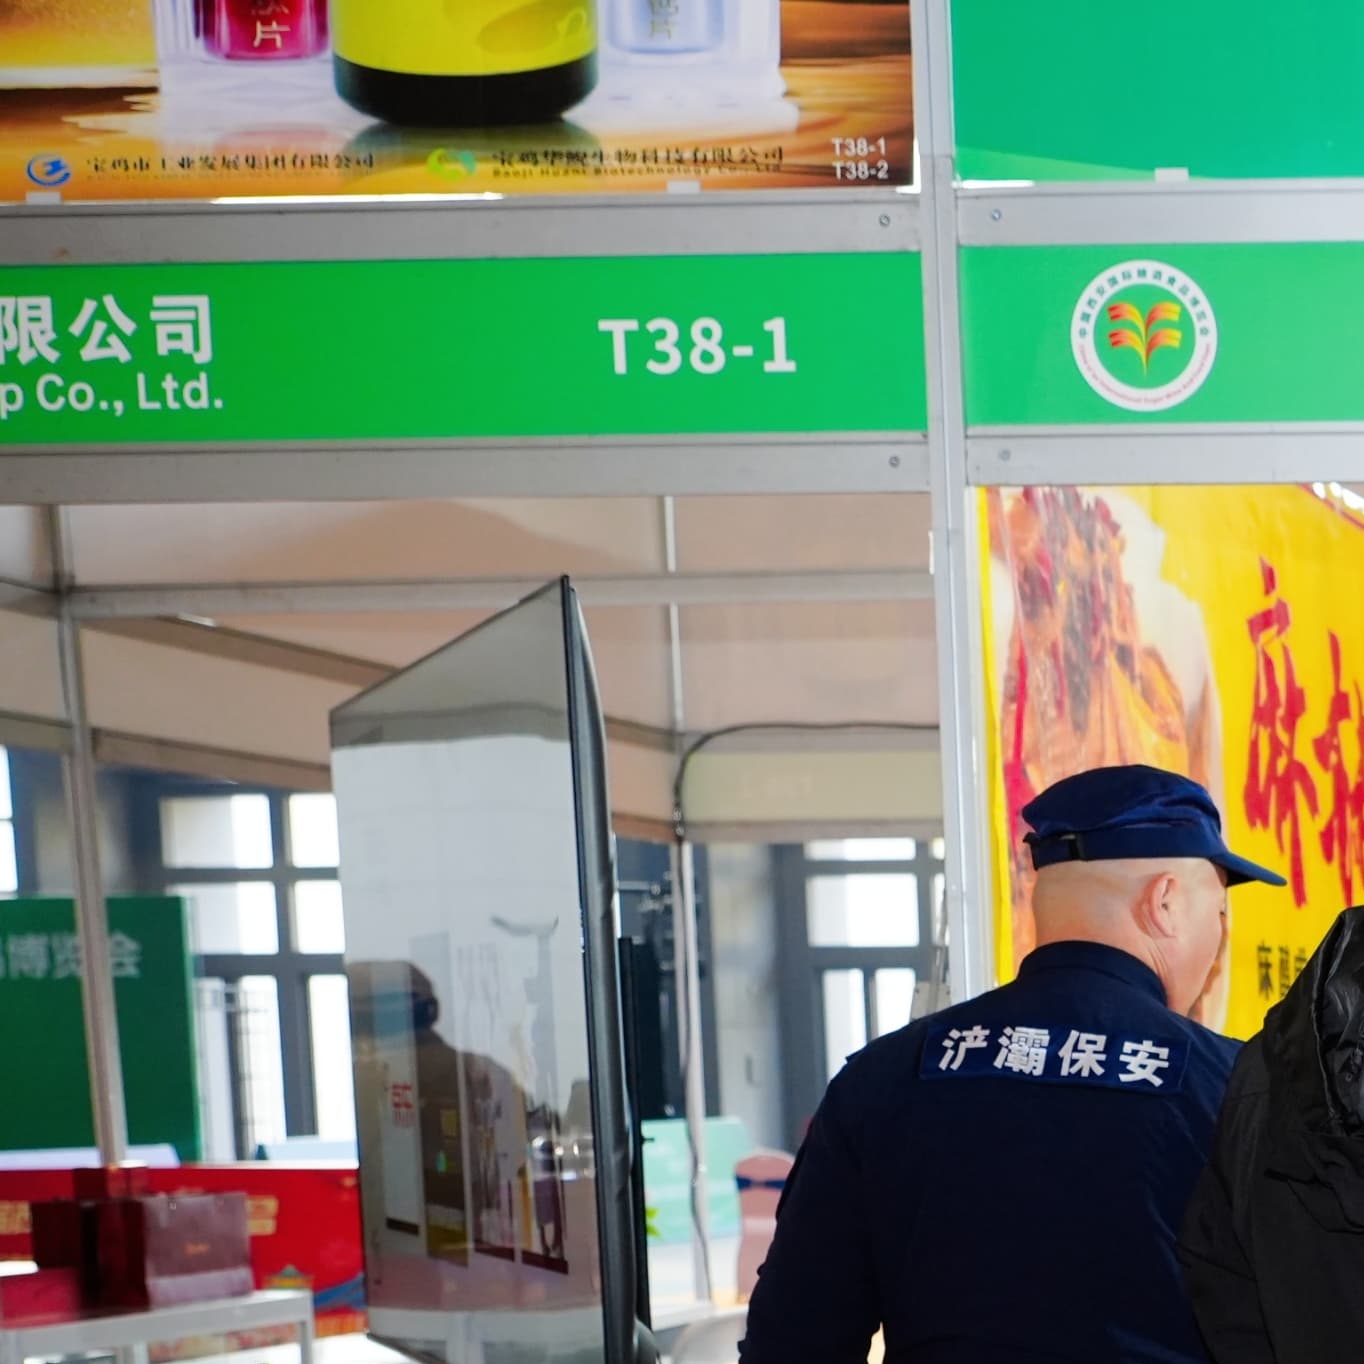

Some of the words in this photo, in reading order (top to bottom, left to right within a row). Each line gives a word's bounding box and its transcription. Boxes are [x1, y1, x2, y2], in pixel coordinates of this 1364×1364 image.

[830, 138, 887, 156] T38-1
[831, 161, 888, 181] T38-2
[0, 294, 212, 365] 限公司
[597, 316, 797, 376] T38-1
[36, 373, 125, 417] Co.,
[136, 371, 224, 411] Ltd.
[937, 1024, 1170, 1088] 浐灞保安
